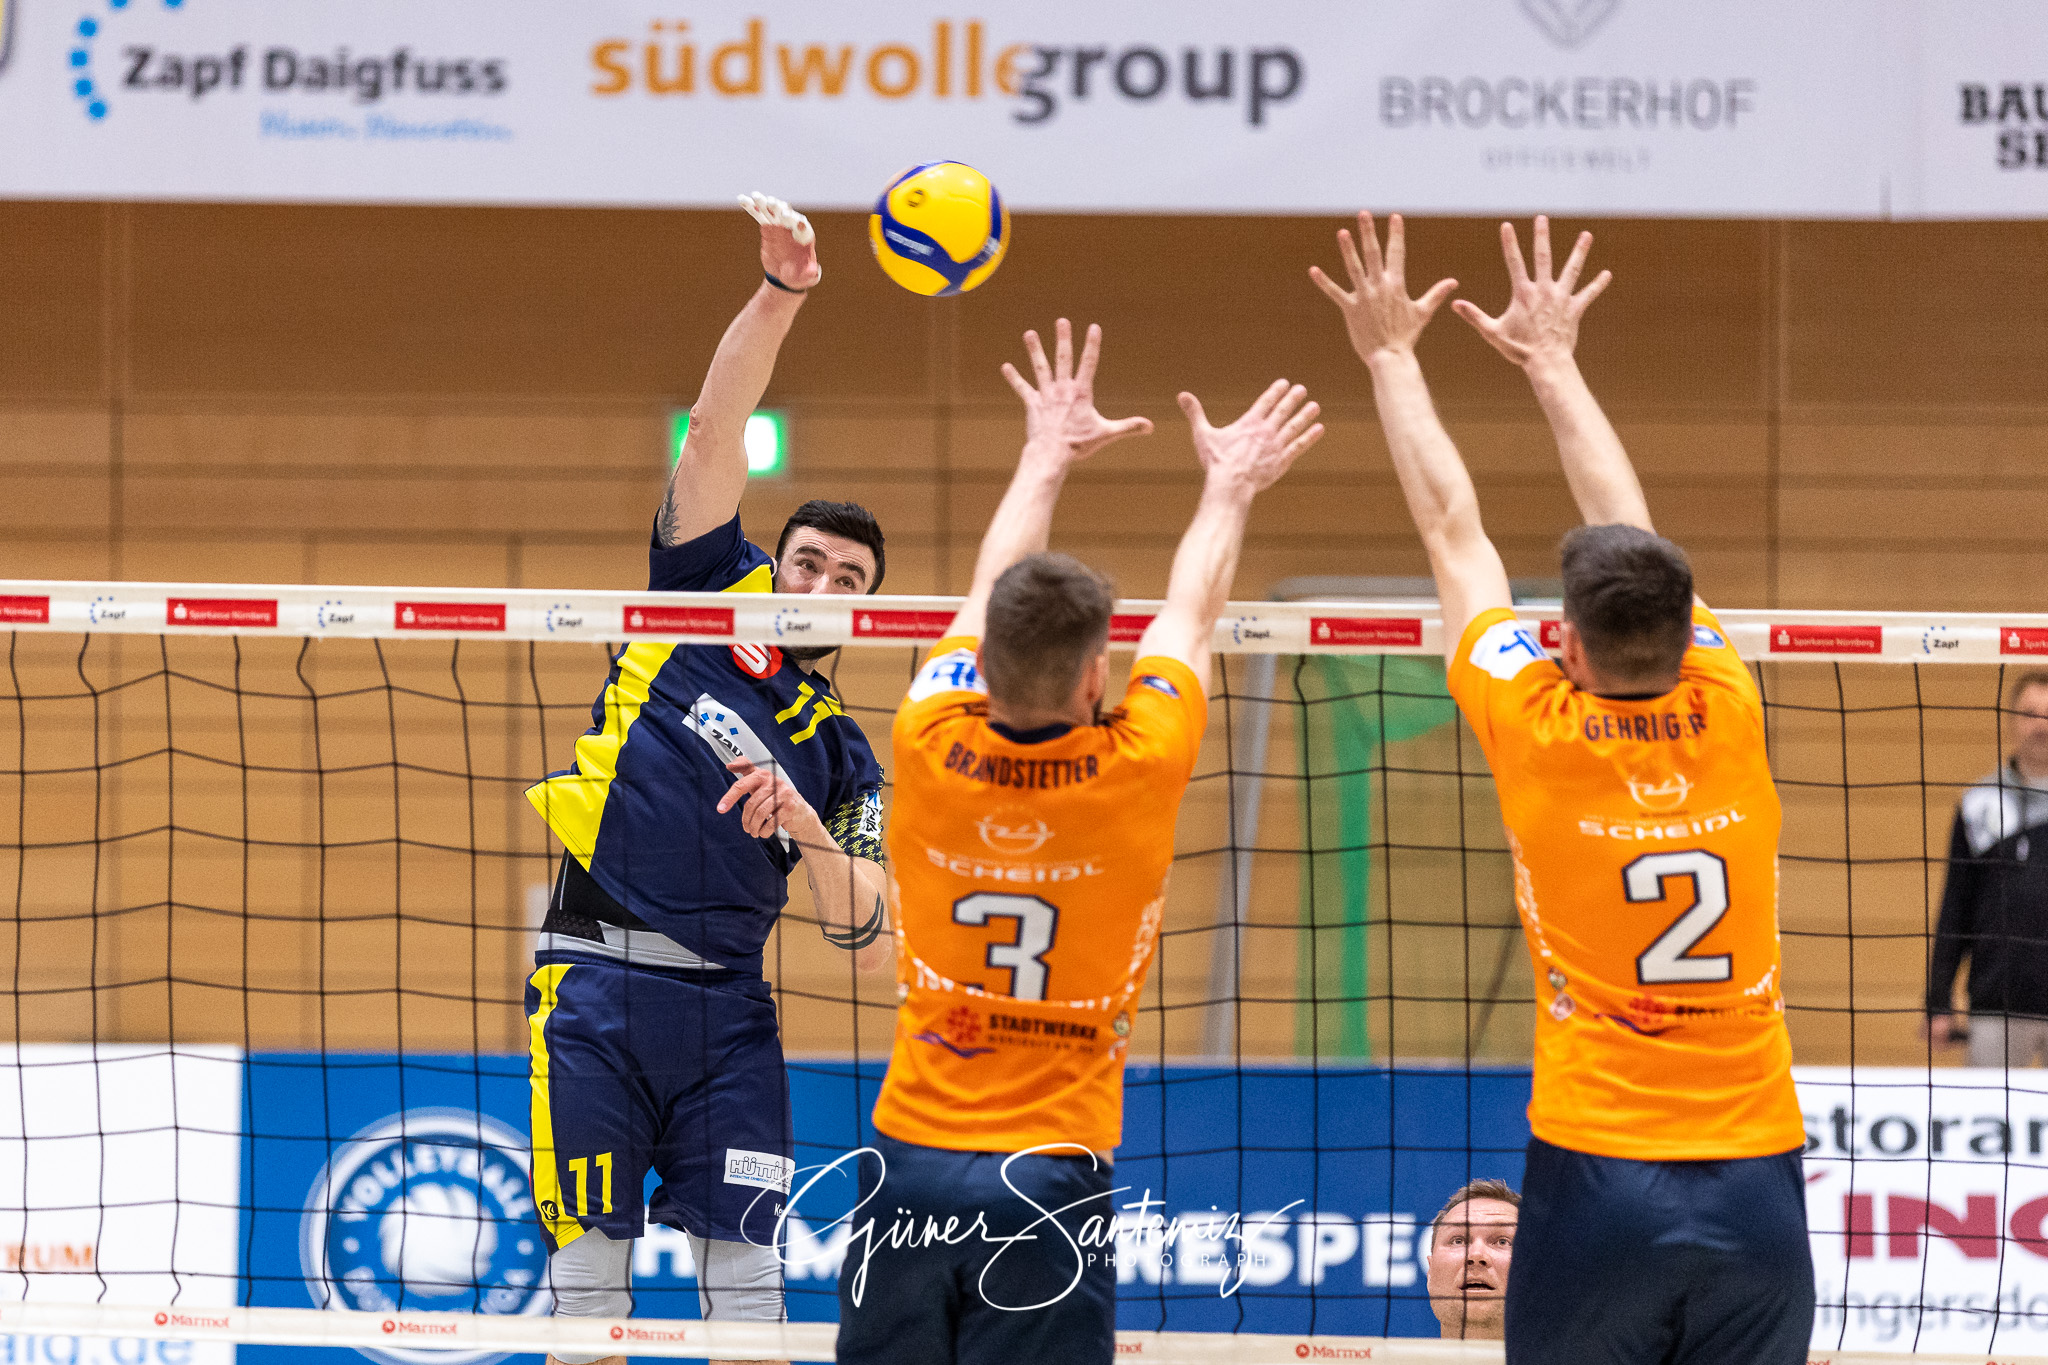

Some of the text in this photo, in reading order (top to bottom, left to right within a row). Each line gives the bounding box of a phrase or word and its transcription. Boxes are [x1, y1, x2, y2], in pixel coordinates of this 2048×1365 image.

[123, 45, 509, 104] Zapf Daigfuss
[1377, 76, 1758, 130] BROCKERHOF
[944, 741, 1099, 790] BRANDSTETTER
[1621, 848, 1733, 985] 2
[953, 890, 1060, 1002] 3
[568, 1152, 613, 1217] 11
[170, 1313, 231, 1330] Marmot
[398, 1320, 458, 1336] Marmot
[626, 1327, 686, 1342] Marmot
[1312, 1345, 1372, 1360] Marmot
